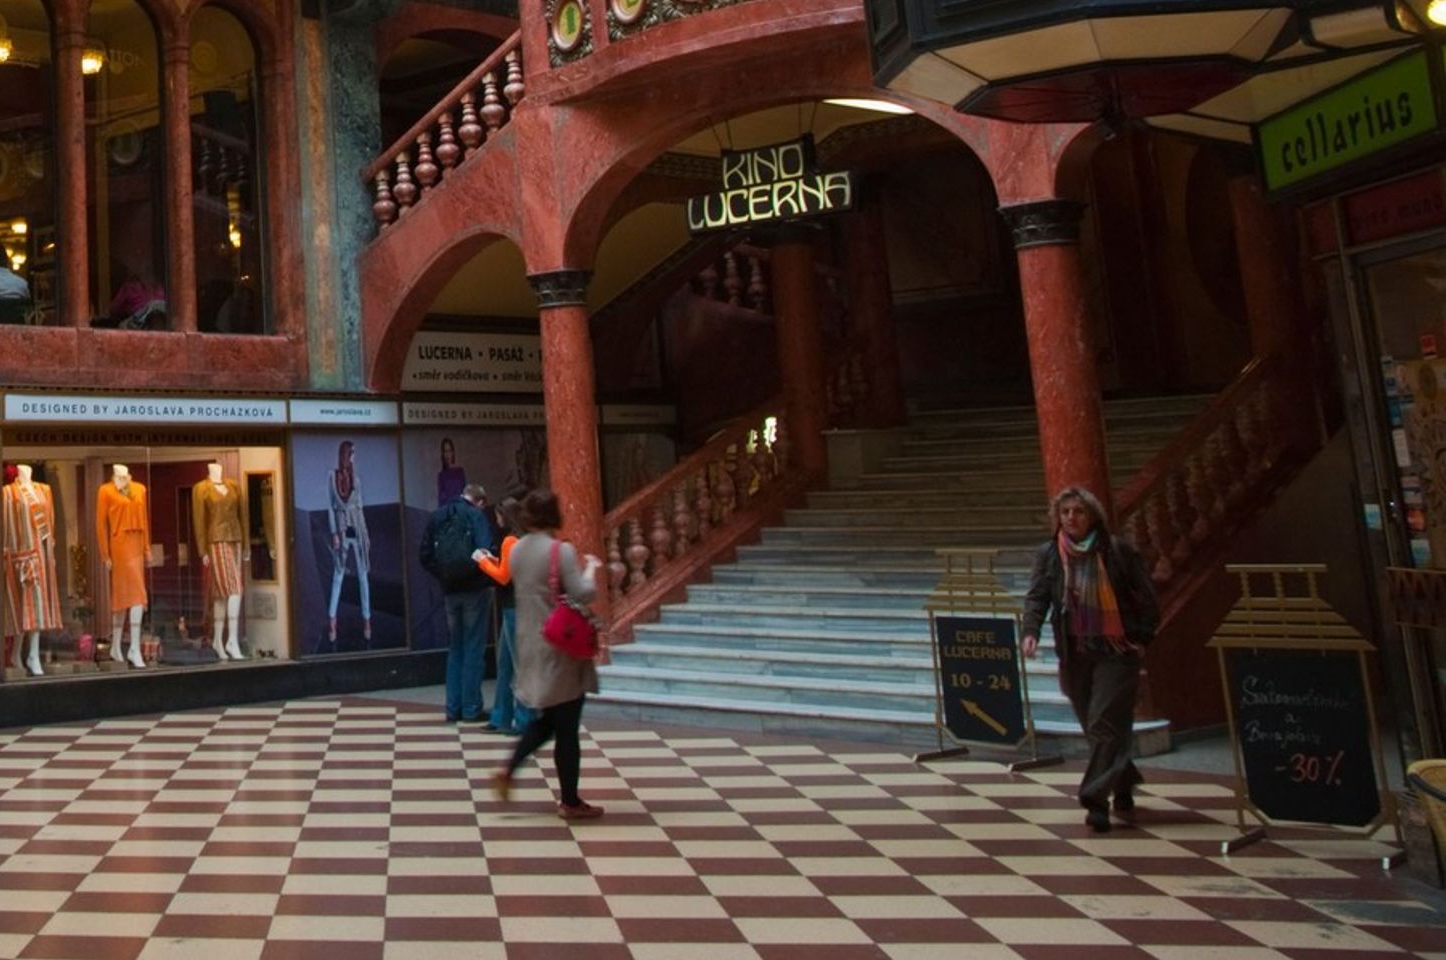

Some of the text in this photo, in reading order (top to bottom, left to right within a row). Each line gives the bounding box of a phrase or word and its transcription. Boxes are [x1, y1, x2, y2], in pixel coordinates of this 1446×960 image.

[1282, 92, 1412, 172] cellarius
[723, 144, 804, 189] KINO
[688, 171, 851, 230] LUCERNA
[418, 346, 473, 360] LUCERNA
[22, 402, 87, 414] DESIGNED
[93, 403, 108, 415] BY
[114, 404, 184, 416] JAROSLAVA
[408, 409, 457, 418] DESIGNED
[943, 644, 1012, 660] LUCERNA
[950, 672, 971, 689] 10
[987, 673, 1011, 691] 24
[1274, 750, 1345, 786] -30%
